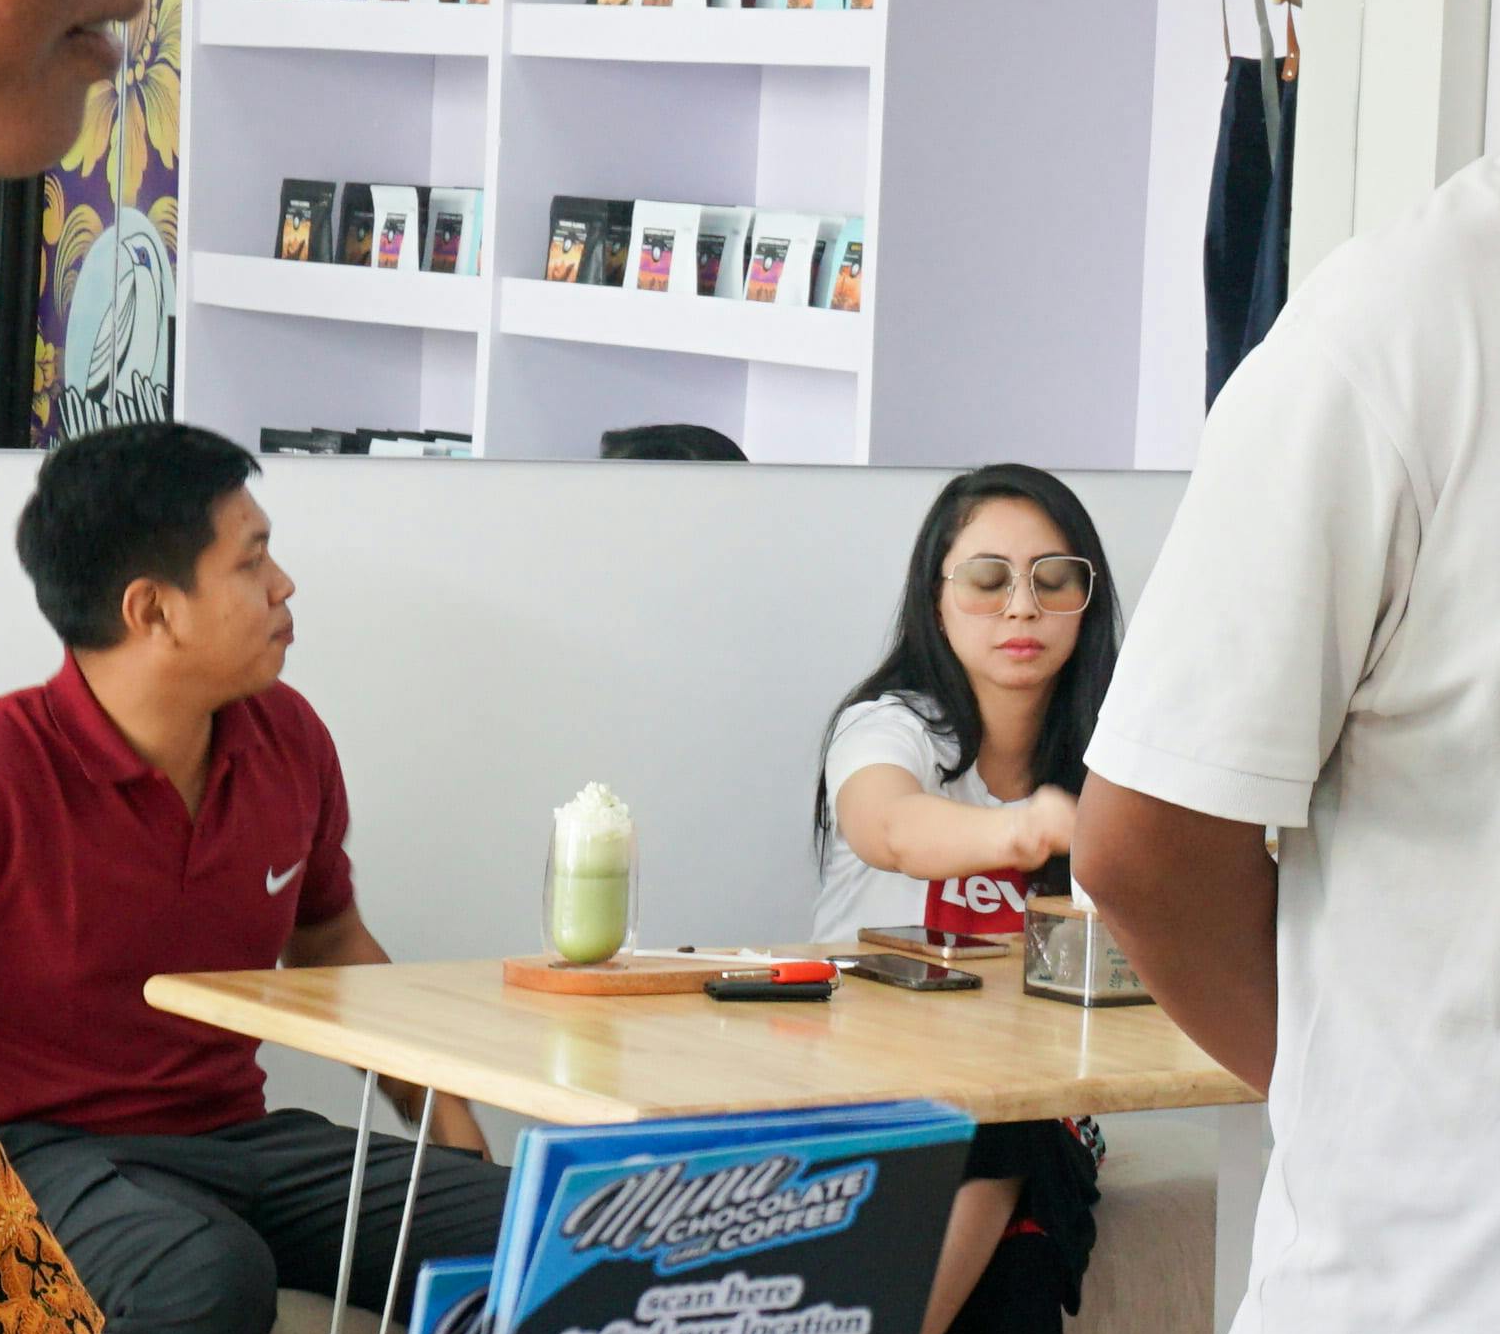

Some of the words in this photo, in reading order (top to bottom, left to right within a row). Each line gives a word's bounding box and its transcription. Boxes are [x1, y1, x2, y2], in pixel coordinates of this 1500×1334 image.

[560, 1155, 799, 1254] Myna
[665, 1169, 869, 1245] CHOCOLATE
[717, 1200, 846, 1252] COFFEE
[648, 1288, 715, 1312] scan
[725, 1281, 794, 1307] here
